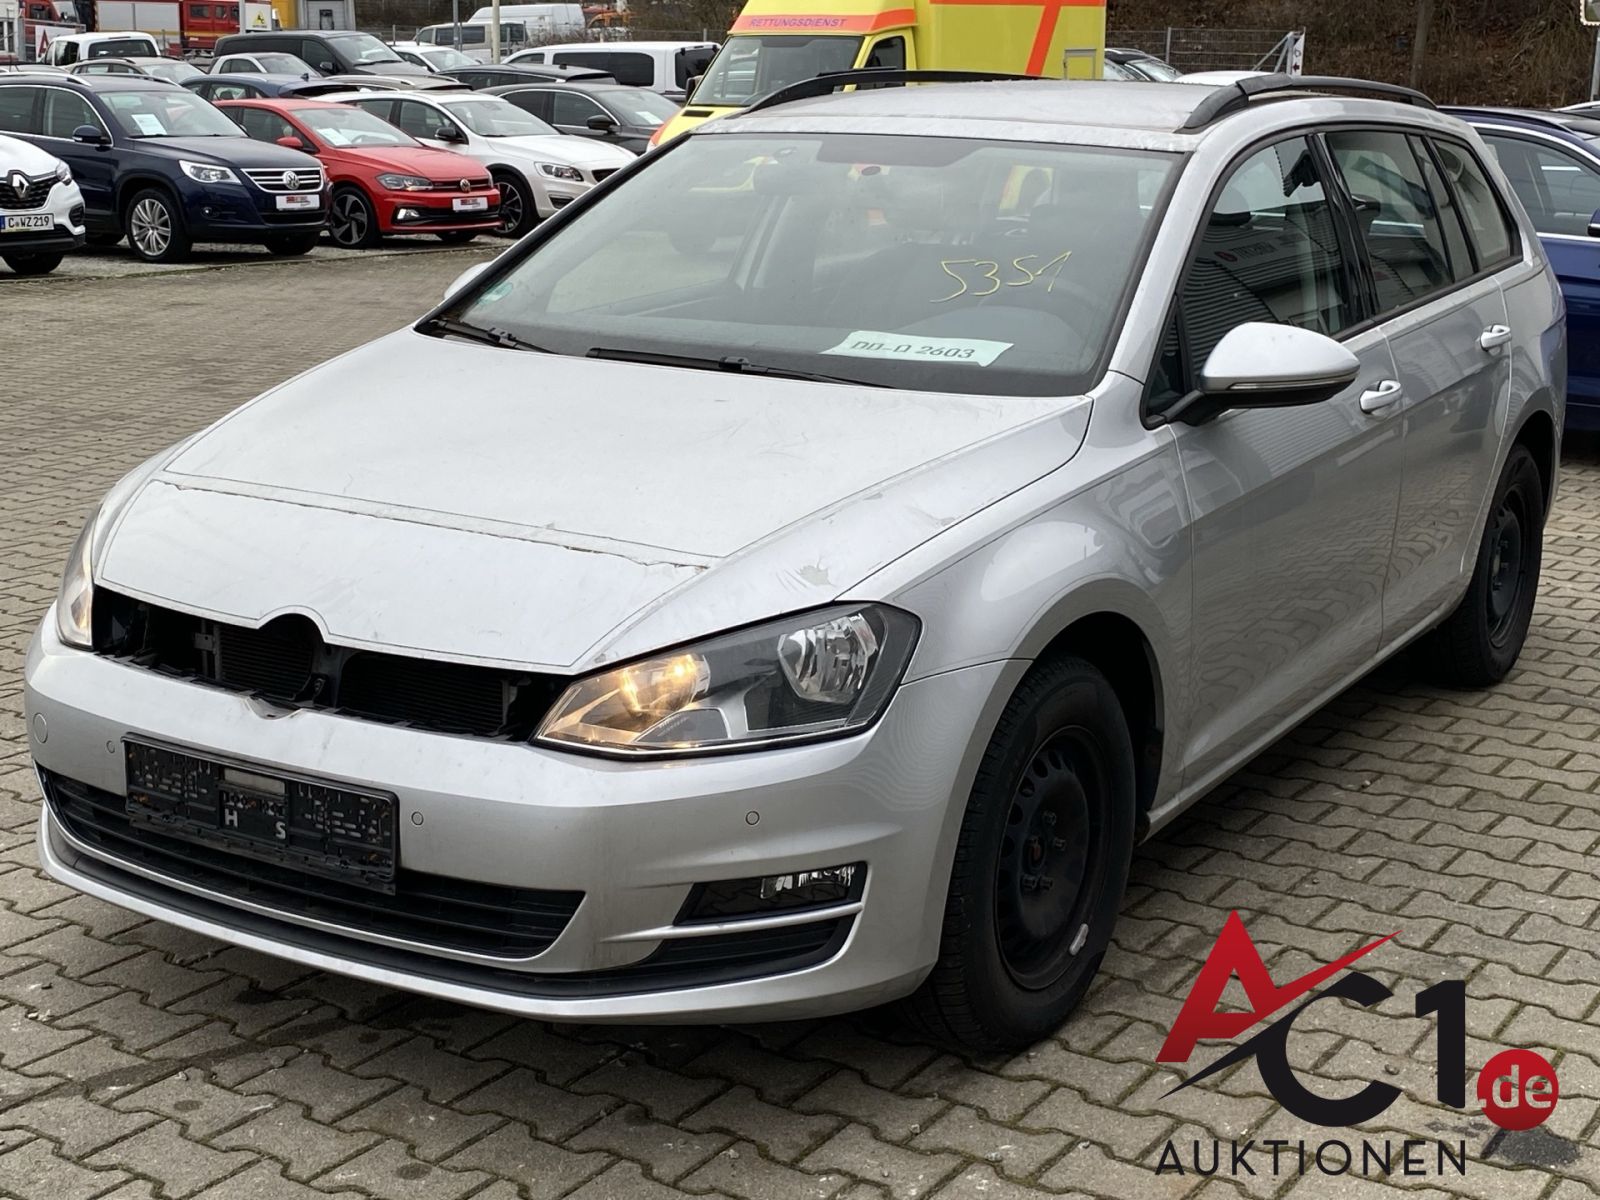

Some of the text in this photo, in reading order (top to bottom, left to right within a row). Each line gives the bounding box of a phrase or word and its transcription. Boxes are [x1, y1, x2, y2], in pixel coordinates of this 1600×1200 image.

[750, 18, 847, 27] RETTUNGSDIENST
[8, 217, 15, 228] C
[915, 346, 975, 359] 2603
